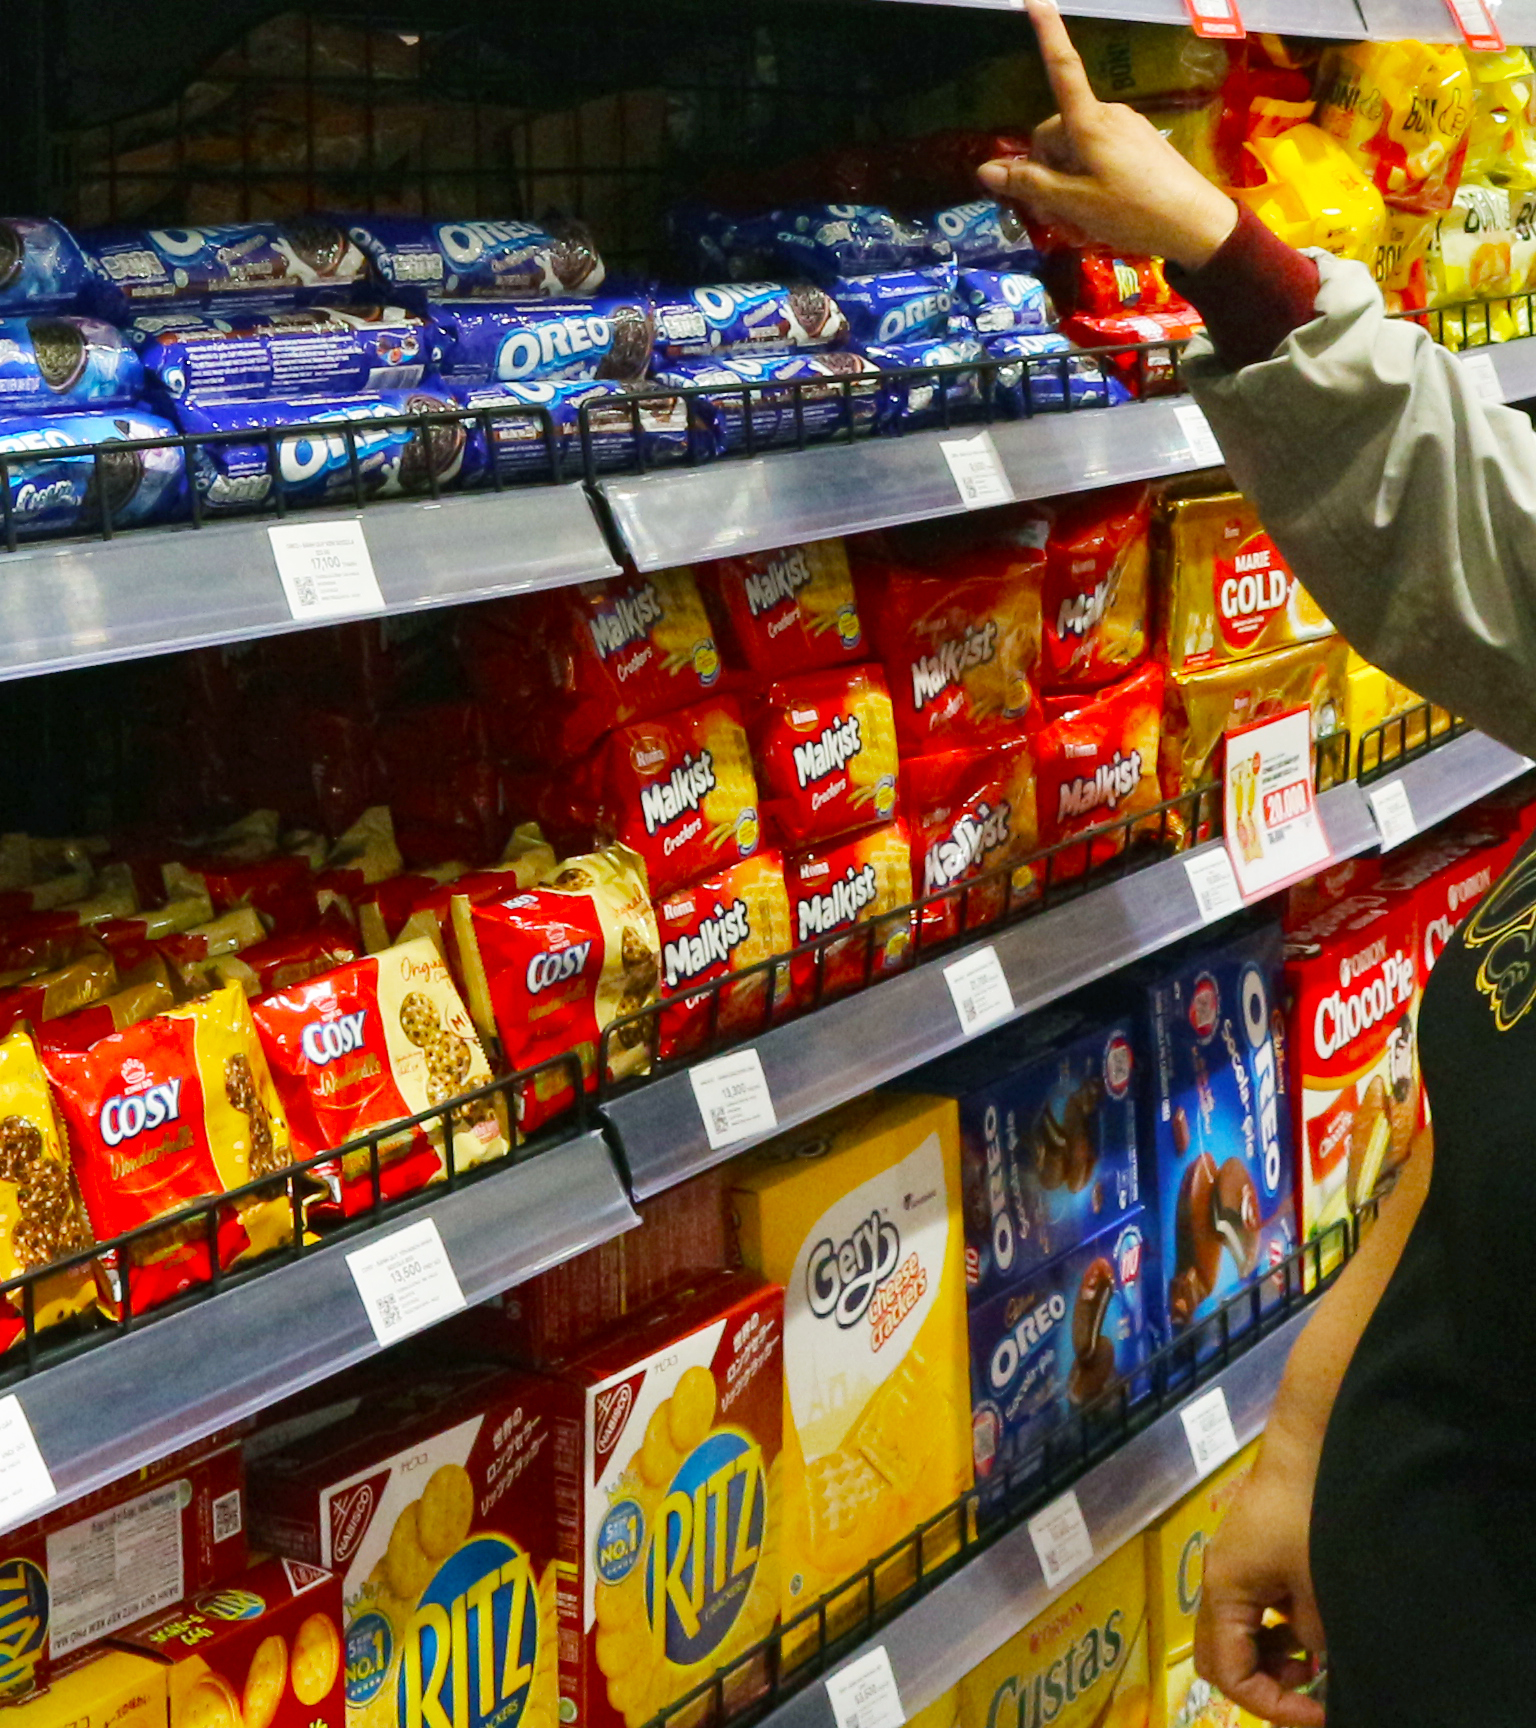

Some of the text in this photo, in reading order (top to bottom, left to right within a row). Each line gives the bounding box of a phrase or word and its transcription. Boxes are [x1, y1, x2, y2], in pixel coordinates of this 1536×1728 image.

[500, 313, 614, 380] OREO
[745, 550, 812, 616] Malkist
[1221, 570, 1287, 618] GOLD
[1235, 550, 1270, 573] MARIE
[591, 586, 664, 659] Malkist
[794, 715, 861, 787] Malkist
[1058, 749, 1141, 823] Malkist
[641, 749, 716, 835] Malkist
[798, 862, 878, 943] Malkist
[799, 859, 831, 879] Roma
[663, 897, 750, 987] Malkist
[664, 897, 696, 920] Roma
[301, 1009, 367, 1066] COSY
[101, 1077, 182, 1147] COSY
[1242, 969, 1281, 1192] OREO
[807, 1209, 899, 1330] Gery
[867, 1251, 919, 1325] cheese
[870, 1267, 929, 1353] crackers
[991, 1294, 1066, 1388] OREO
[599, 1386, 631, 1453] NABISCO
[335, 1488, 371, 1559] NABISCO
[653, 1443, 763, 1665] RITZ
[399, 1552, 533, 1728] RITZ
